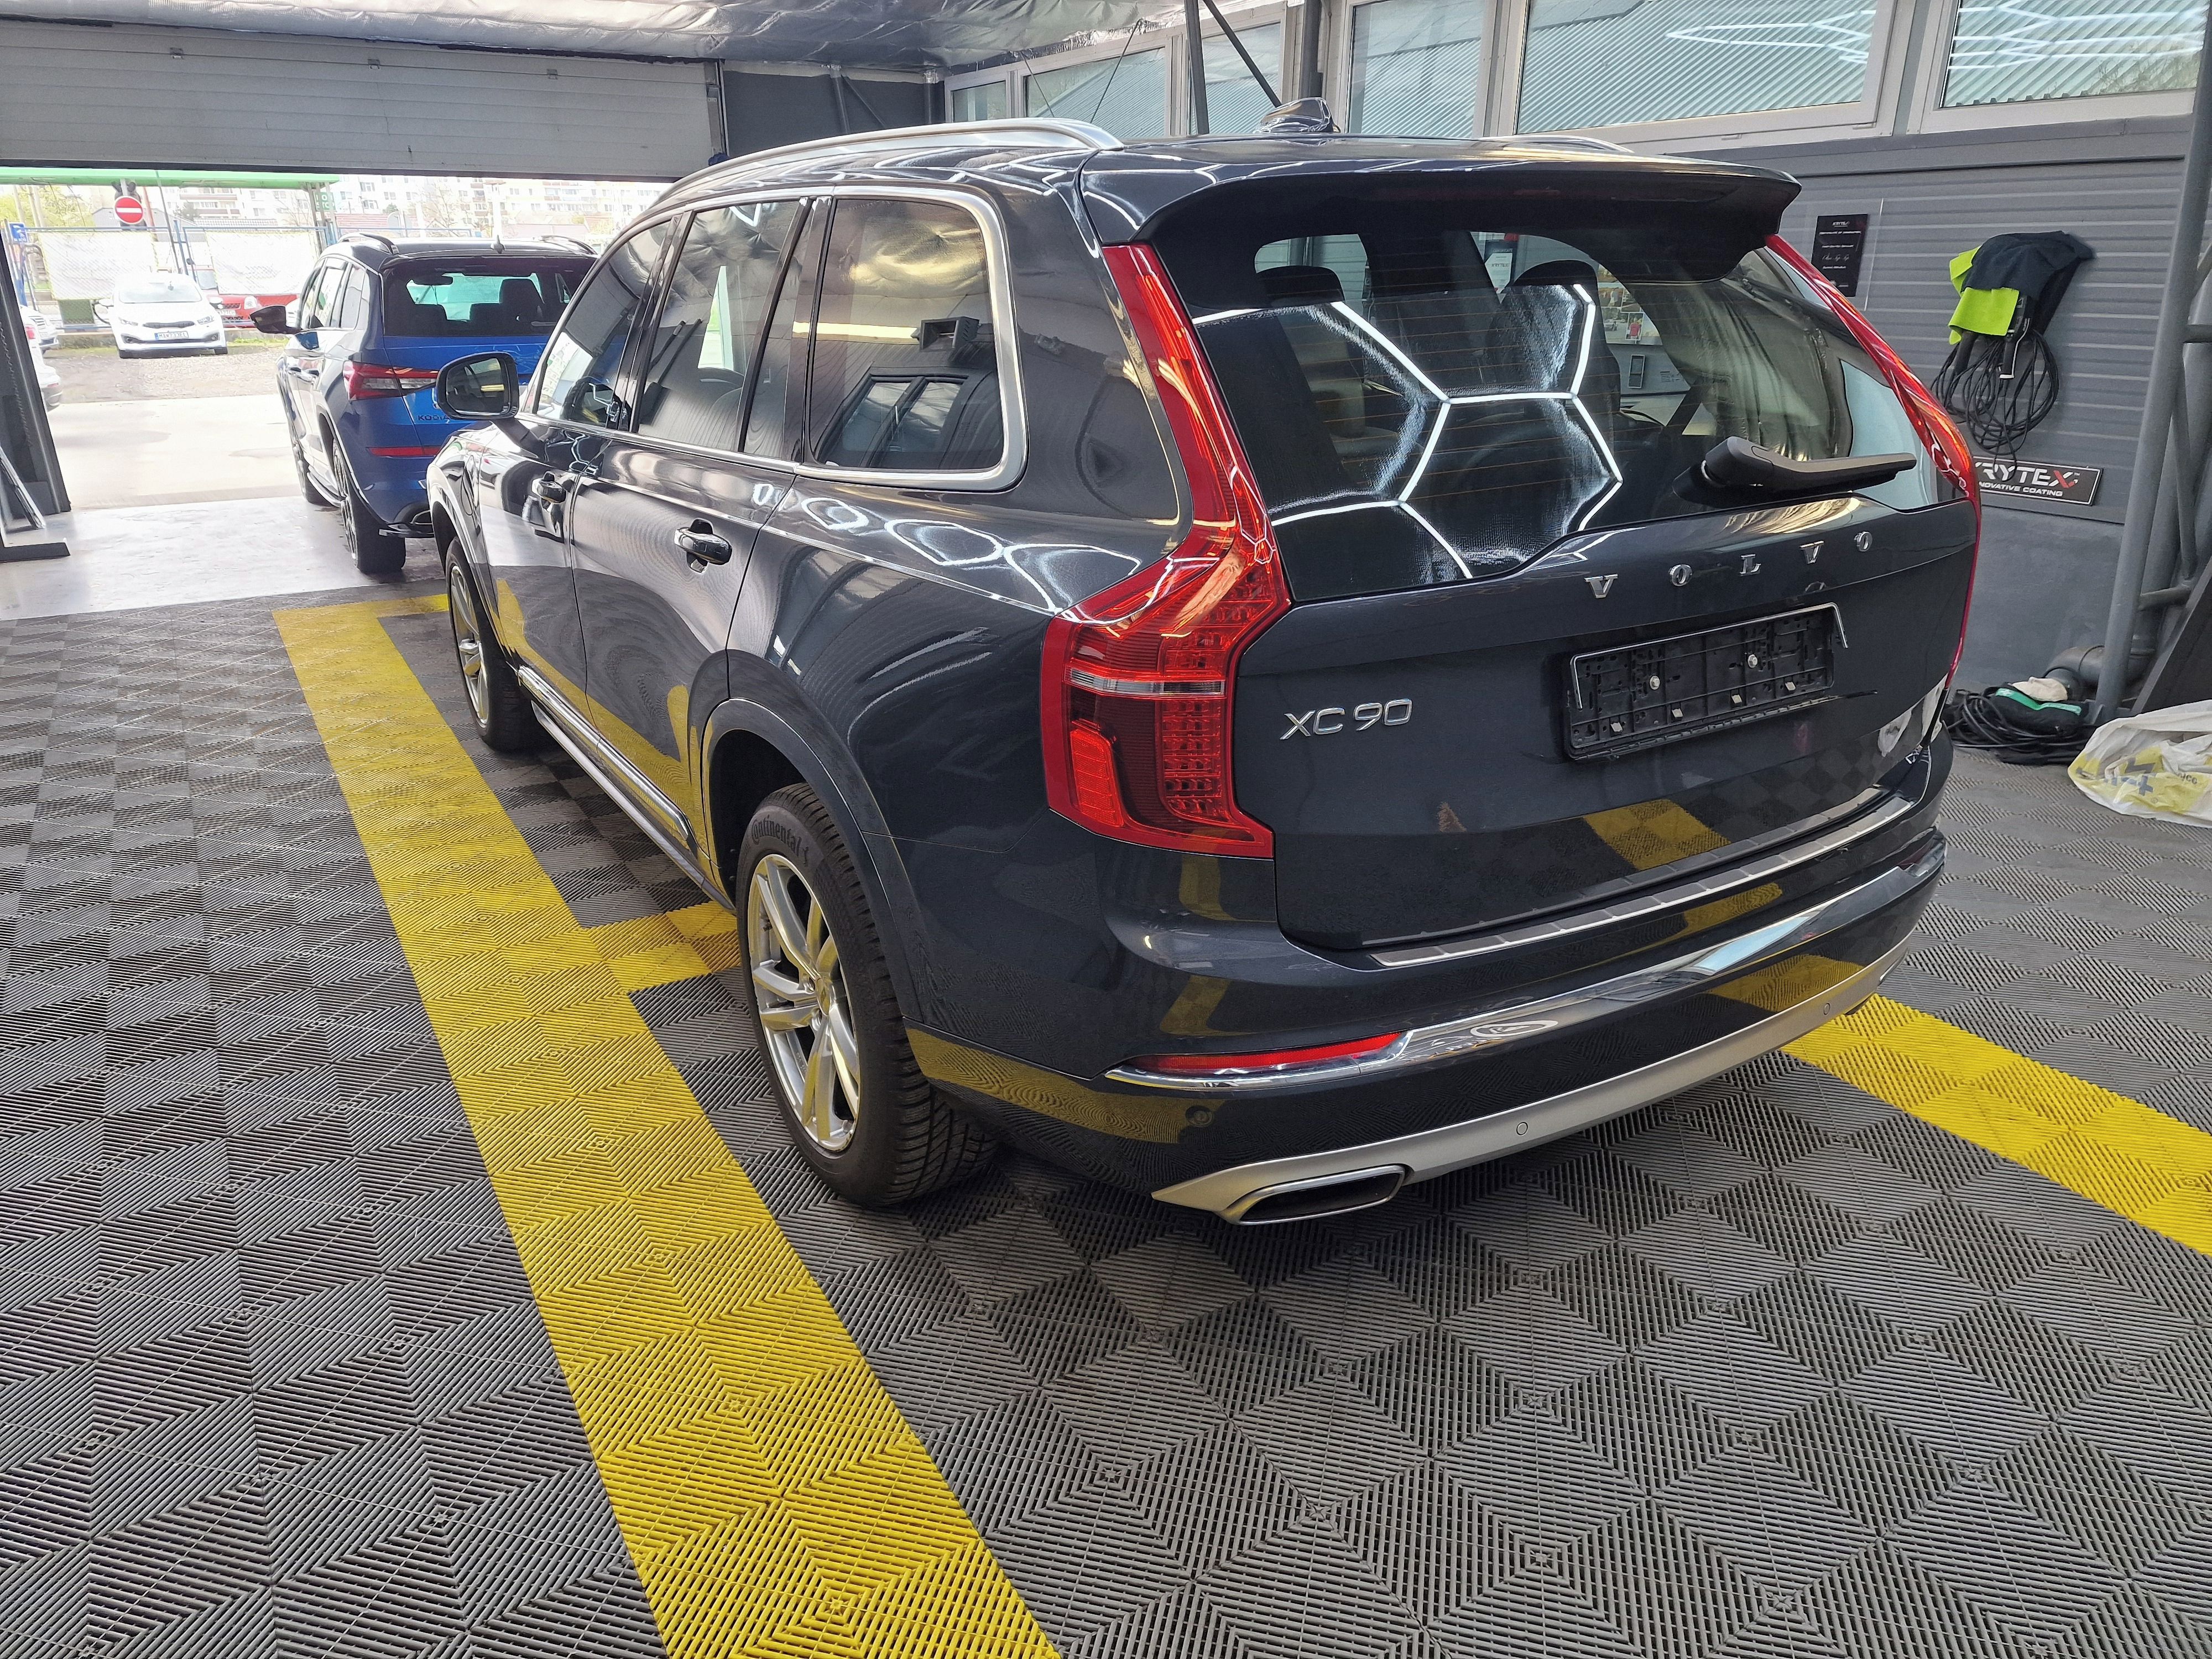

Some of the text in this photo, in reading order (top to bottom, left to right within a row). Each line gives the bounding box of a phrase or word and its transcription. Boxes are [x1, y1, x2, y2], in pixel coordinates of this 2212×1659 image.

[1979, 481, 2063, 497] NOVATIVE COATING
[1584, 531, 1873, 599] VOLVO
[752, 814, 802, 858] Continental
